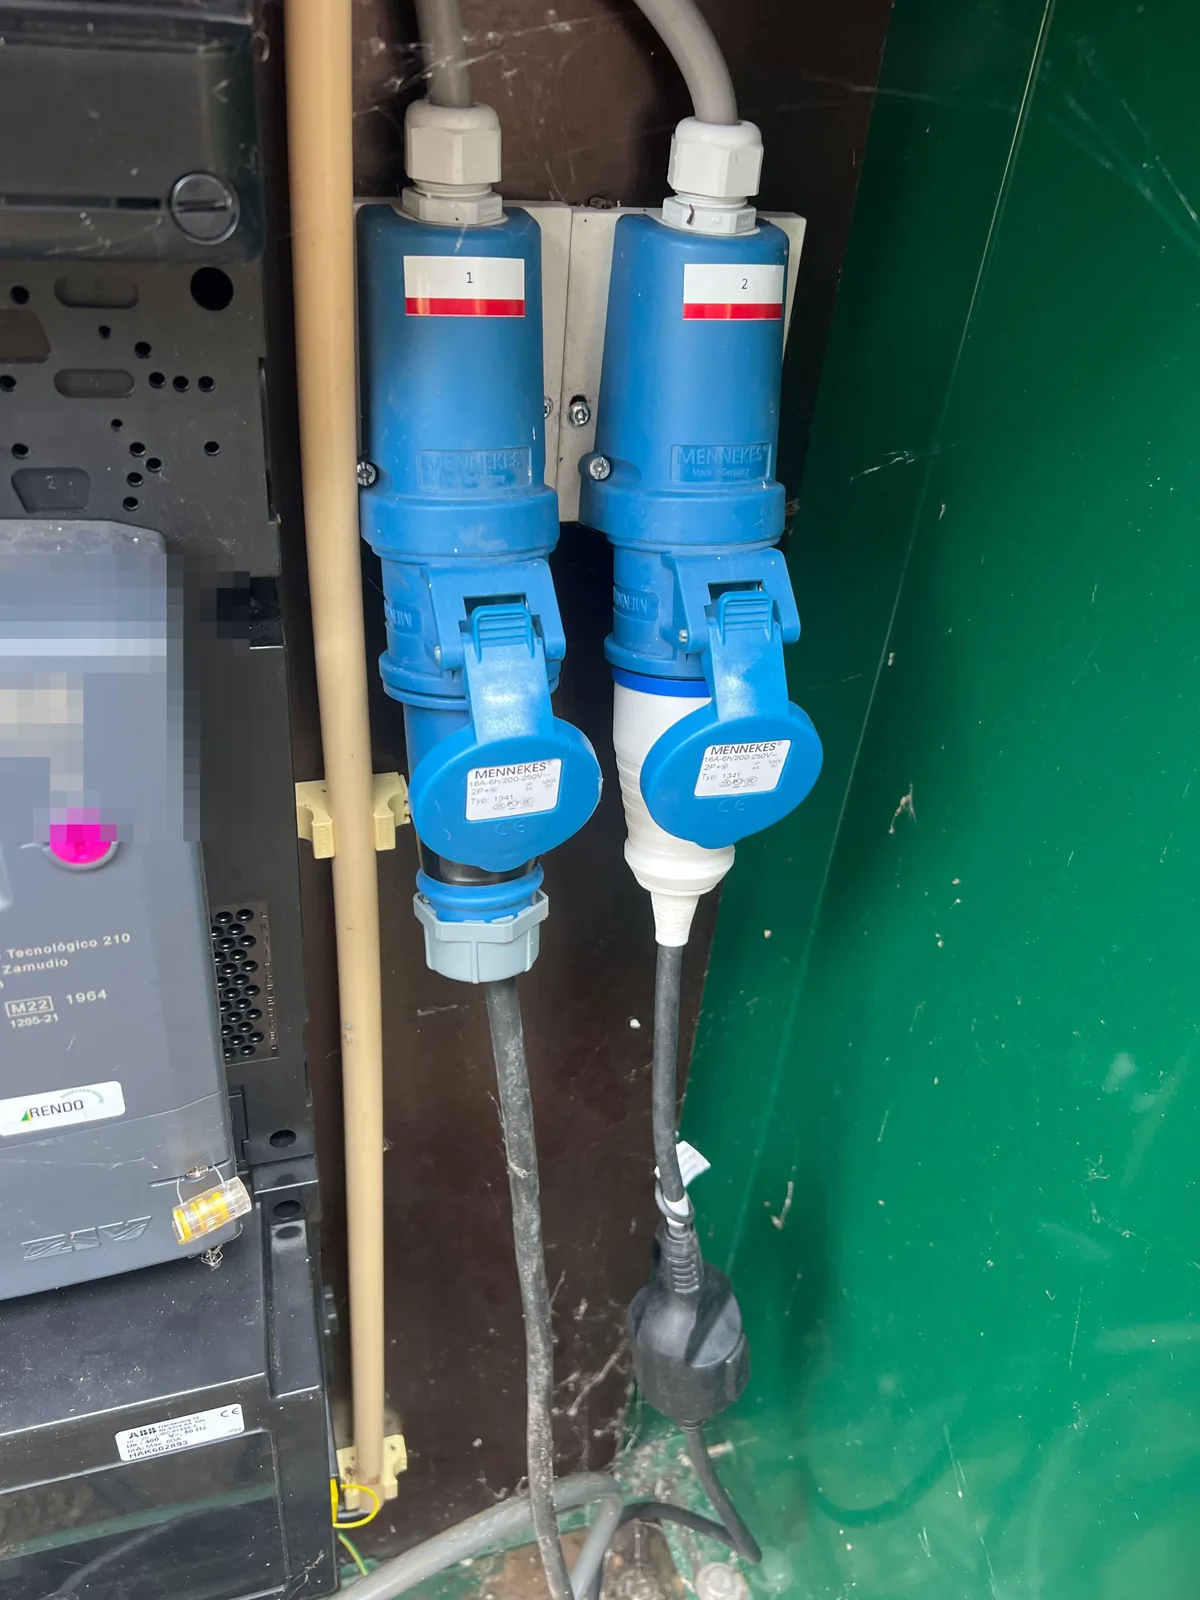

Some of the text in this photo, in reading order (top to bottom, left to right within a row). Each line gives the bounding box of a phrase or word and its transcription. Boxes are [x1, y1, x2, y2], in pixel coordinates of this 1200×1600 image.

[466, 271, 474, 284] 1
[741, 278, 749, 290] 2
[421, 451, 522, 471] MENNEKES
[677, 445, 763, 465] MENNEKES
[710, 742, 777, 756] MENNEKES
[474, 761, 547, 779] MENNEKES
[722, 772, 741, 780] 1341
[494, 794, 513, 803] 1341
[6, 932, 131, 959] Tecnológico 210
[2, 958, 69, 975] Zamudio
[11, 988, 108, 1015] M22 1964
[29, 1099, 84, 1118] RENDO
[129, 1427, 157, 1440] ABB
[129, 1440, 188, 1459] HAK602893
